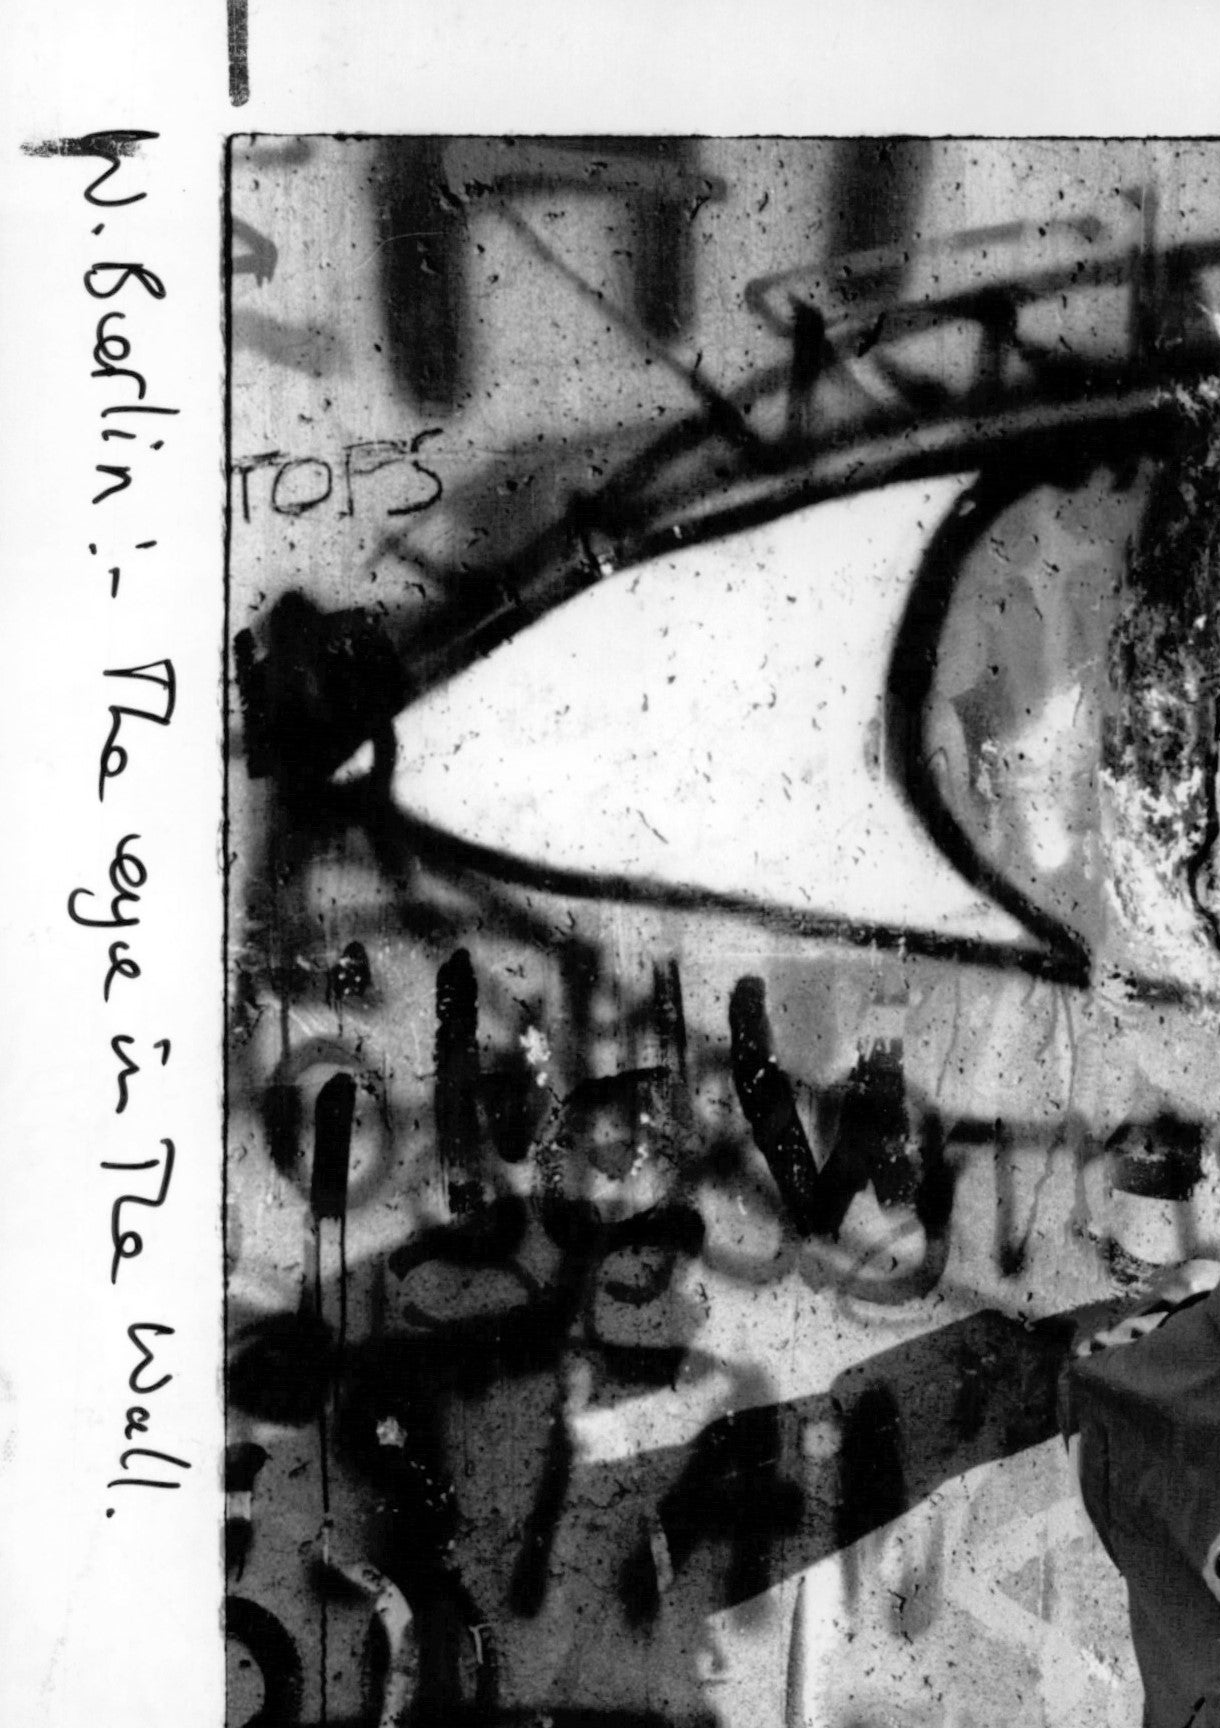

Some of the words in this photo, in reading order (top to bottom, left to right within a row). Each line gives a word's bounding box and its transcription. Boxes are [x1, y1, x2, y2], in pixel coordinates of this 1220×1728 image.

[98, 658, 176, 803] The
[67, 833, 148, 1003] eye
[110, 1034, 171, 1114] in
[100, 1137, 176, 1285] The
